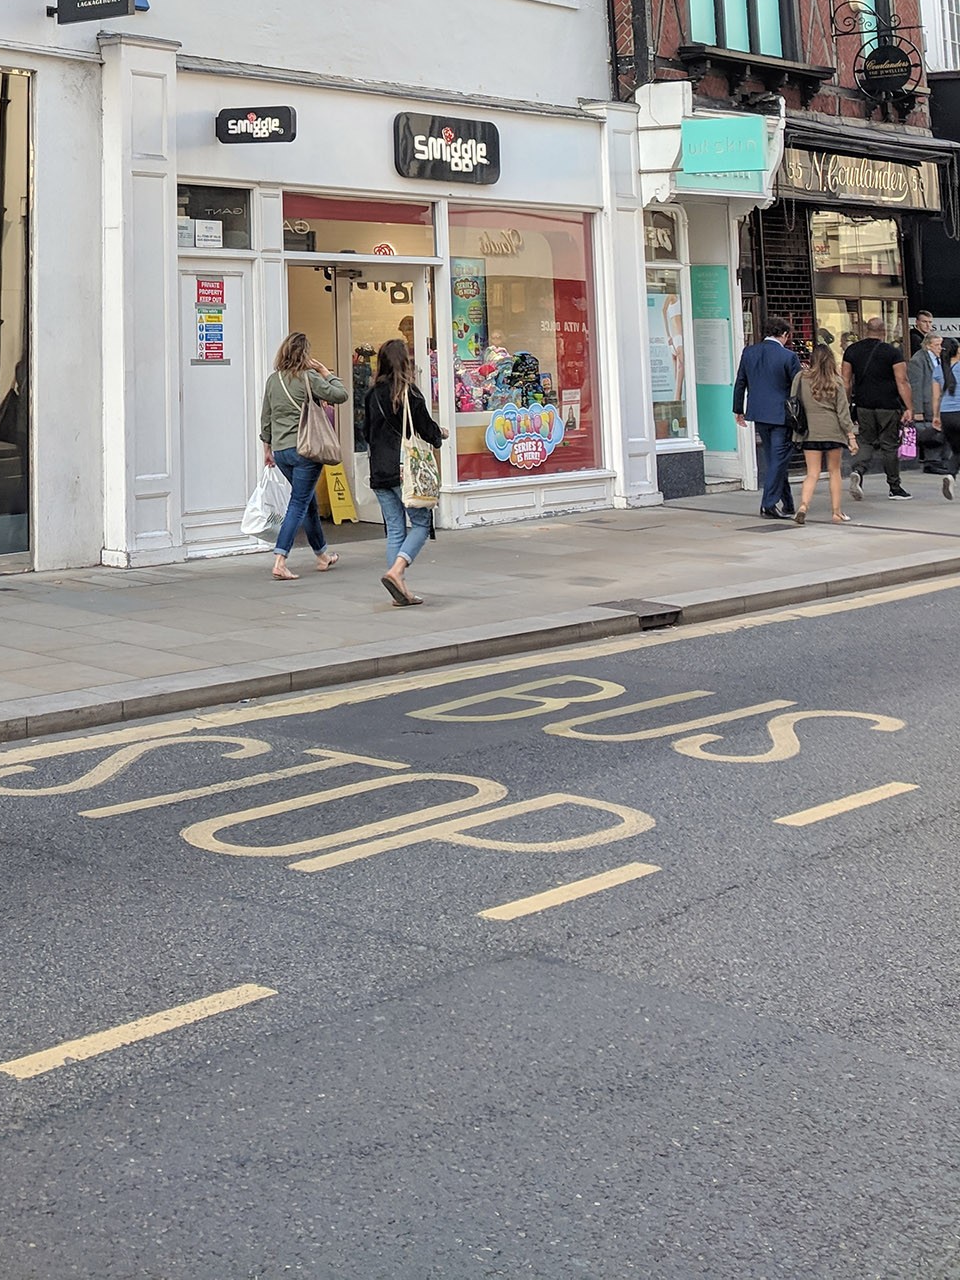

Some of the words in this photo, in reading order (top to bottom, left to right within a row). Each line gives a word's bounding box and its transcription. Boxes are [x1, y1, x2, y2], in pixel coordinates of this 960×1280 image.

[788, 162, 803, 180] 55
[201, 281, 220, 289] PRIVATE
[940, 324, 960, 332] LAN
[513, 441, 537, 455] SERIES
[536, 440, 543, 452] 2
[405, 674, 906, 764] BUS
